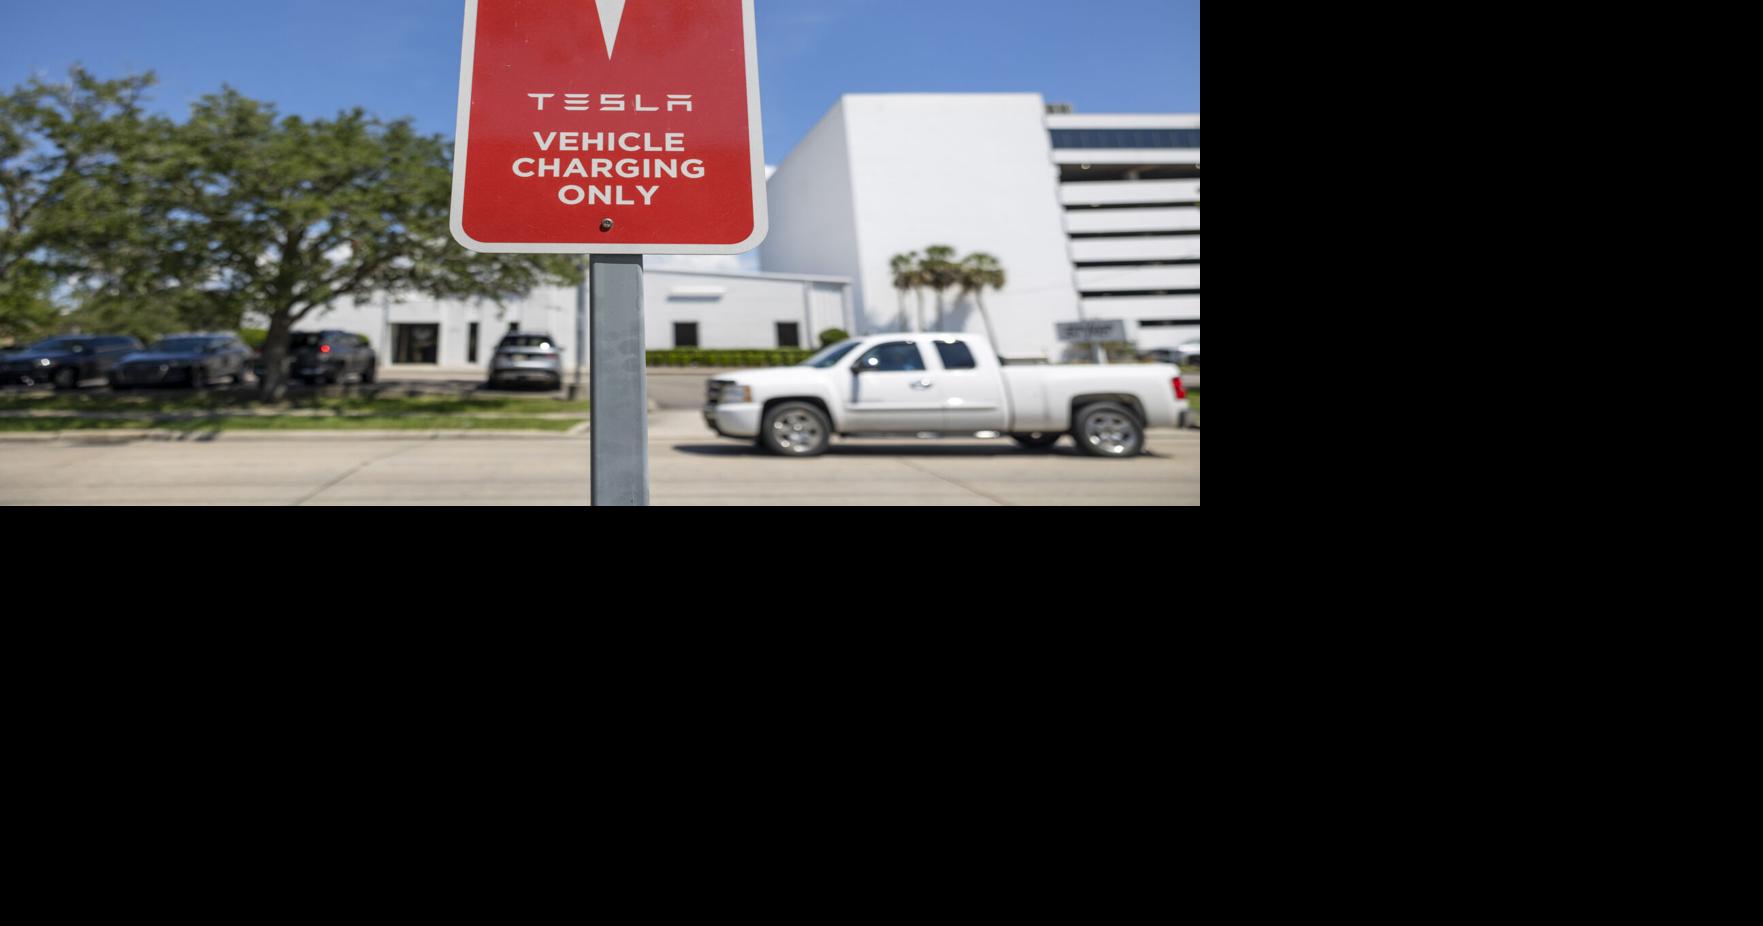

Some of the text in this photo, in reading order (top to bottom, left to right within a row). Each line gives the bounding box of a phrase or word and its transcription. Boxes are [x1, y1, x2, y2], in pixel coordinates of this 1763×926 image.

[527, 93, 693, 112] TESLA
[532, 131, 685, 152] VEHICLE
[511, 157, 705, 179] CHARGING
[557, 184, 660, 206] ONLY
